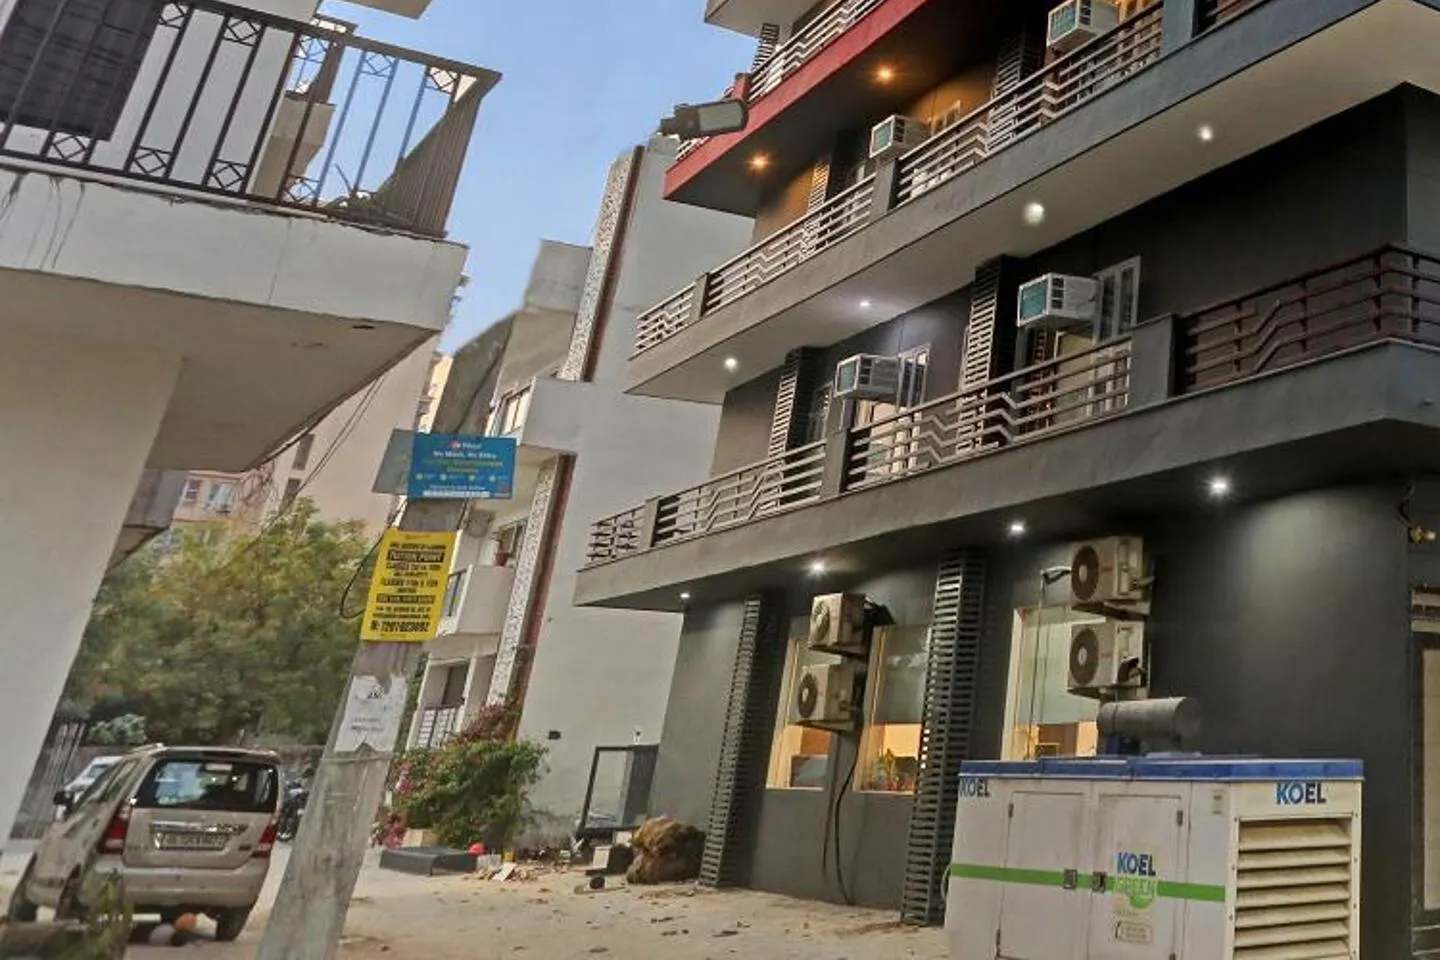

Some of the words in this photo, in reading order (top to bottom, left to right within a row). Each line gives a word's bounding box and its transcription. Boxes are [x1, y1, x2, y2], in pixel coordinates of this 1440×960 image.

[959, 777, 991, 798] KOEL
[1276, 782, 1326, 805] KOEL
[1117, 852, 1156, 876] KOEL
